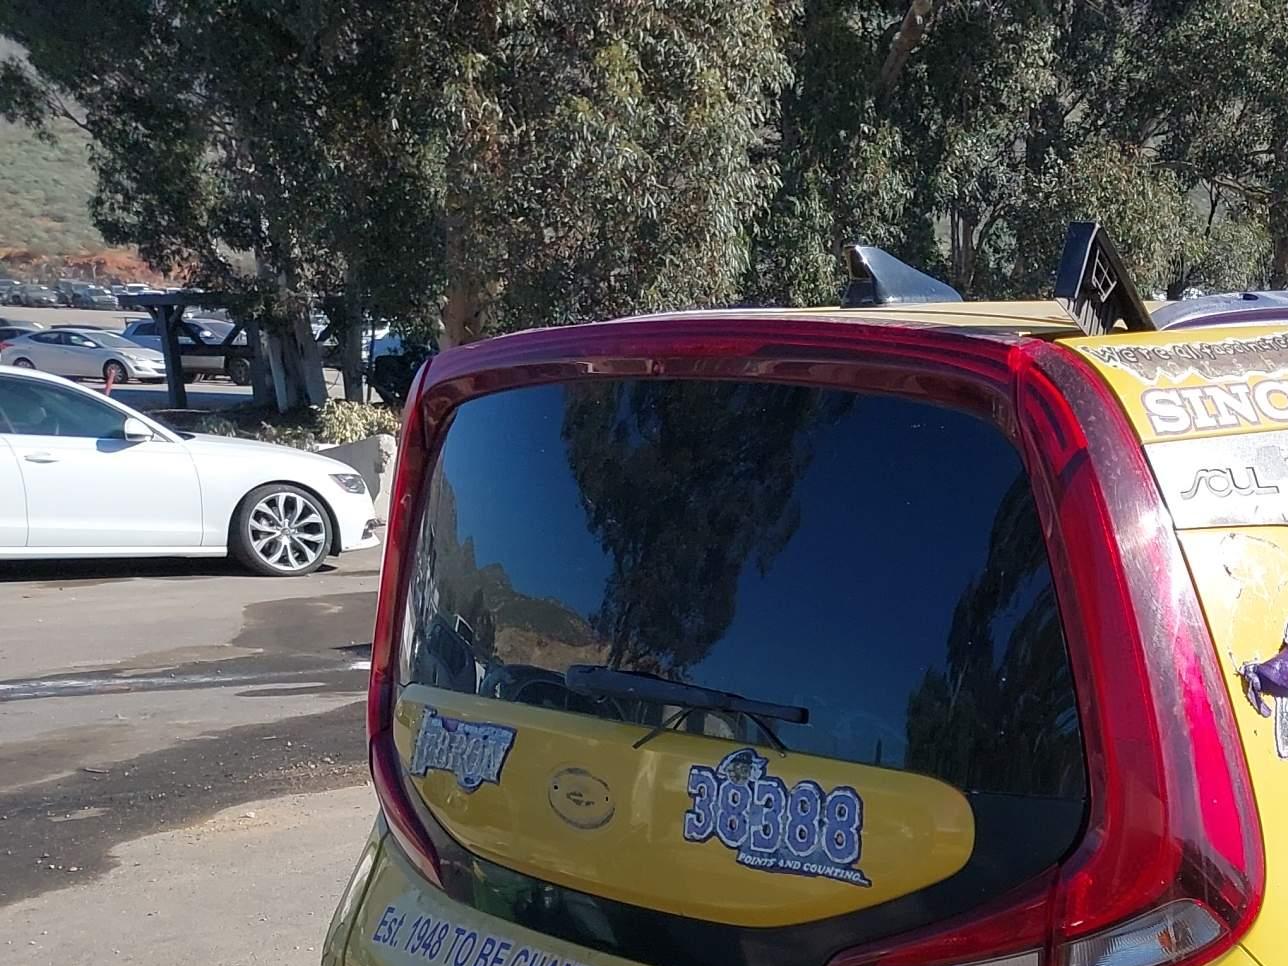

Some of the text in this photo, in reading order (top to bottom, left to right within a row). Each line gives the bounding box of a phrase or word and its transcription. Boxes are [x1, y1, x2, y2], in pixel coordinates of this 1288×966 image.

[1180, 467, 1279, 500] SOUL
[684, 765, 863, 866] 38388
[738, 852, 776, 868] POINTS
[778, 858, 801, 871] AND
[404, 915, 450, 960] 1948
